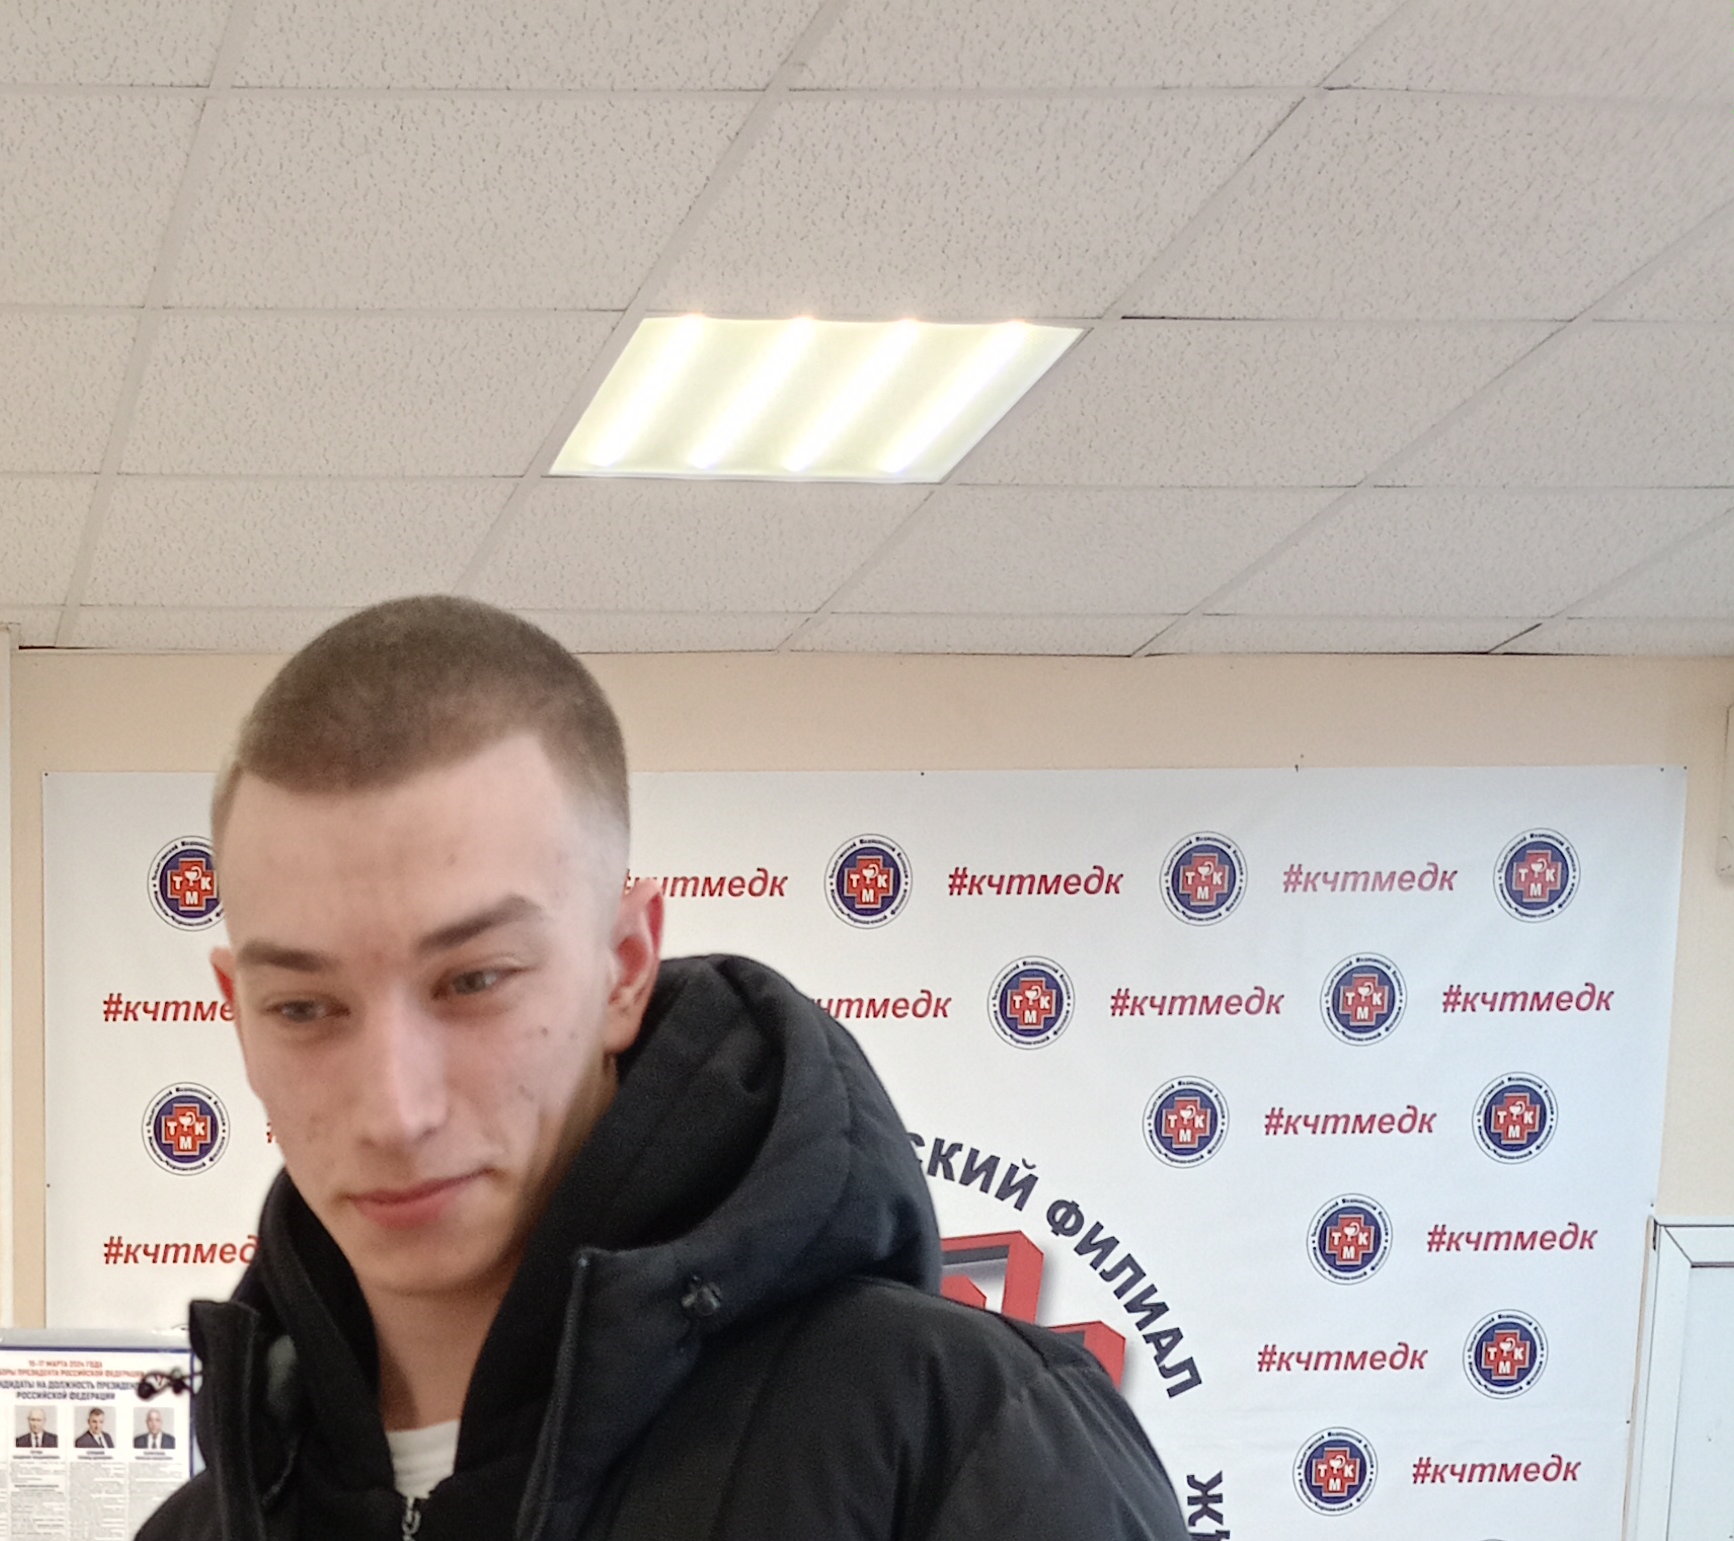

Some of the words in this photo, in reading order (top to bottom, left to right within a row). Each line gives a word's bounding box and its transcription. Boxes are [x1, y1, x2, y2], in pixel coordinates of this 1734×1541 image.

[948, 865, 1124, 896] #кчтмедк
[1282, 864, 1458, 894] #кчтмедк
[103, 993, 236, 1022] #кчтме
[1110, 988, 1284, 1018] #кчтмедк
[1442, 984, 1613, 1014] #кчтмедк
[1264, 1106, 1436, 1136] #кчтмедк
[103, 1235, 261, 1265] #кчтмед
[1427, 1224, 1597, 1252] #кчтмедк
[1046, 1198, 1202, 1399] ФИЛИАЛ
[1257, 1343, 1427, 1372] #кчтмедк
[18, 1368, 60, 1377] ПРЕЗИДЕНТА
[60, 1368, 104, 1378] РОССИЙСКОЙ
[36, 1380, 47, 1390] НА
[48, 1380, 95, 1390] ДОЛЖНОСТЬ
[96, 1382, 139, 1391] ПРЕЗИДЕН
[16, 1391, 68, 1400] РОССИЙСКОЙ
[70, 1392, 116, 1401] ФЕДЕРАЦИИ
[1412, 1455, 1580, 1484] #кчтмедк
